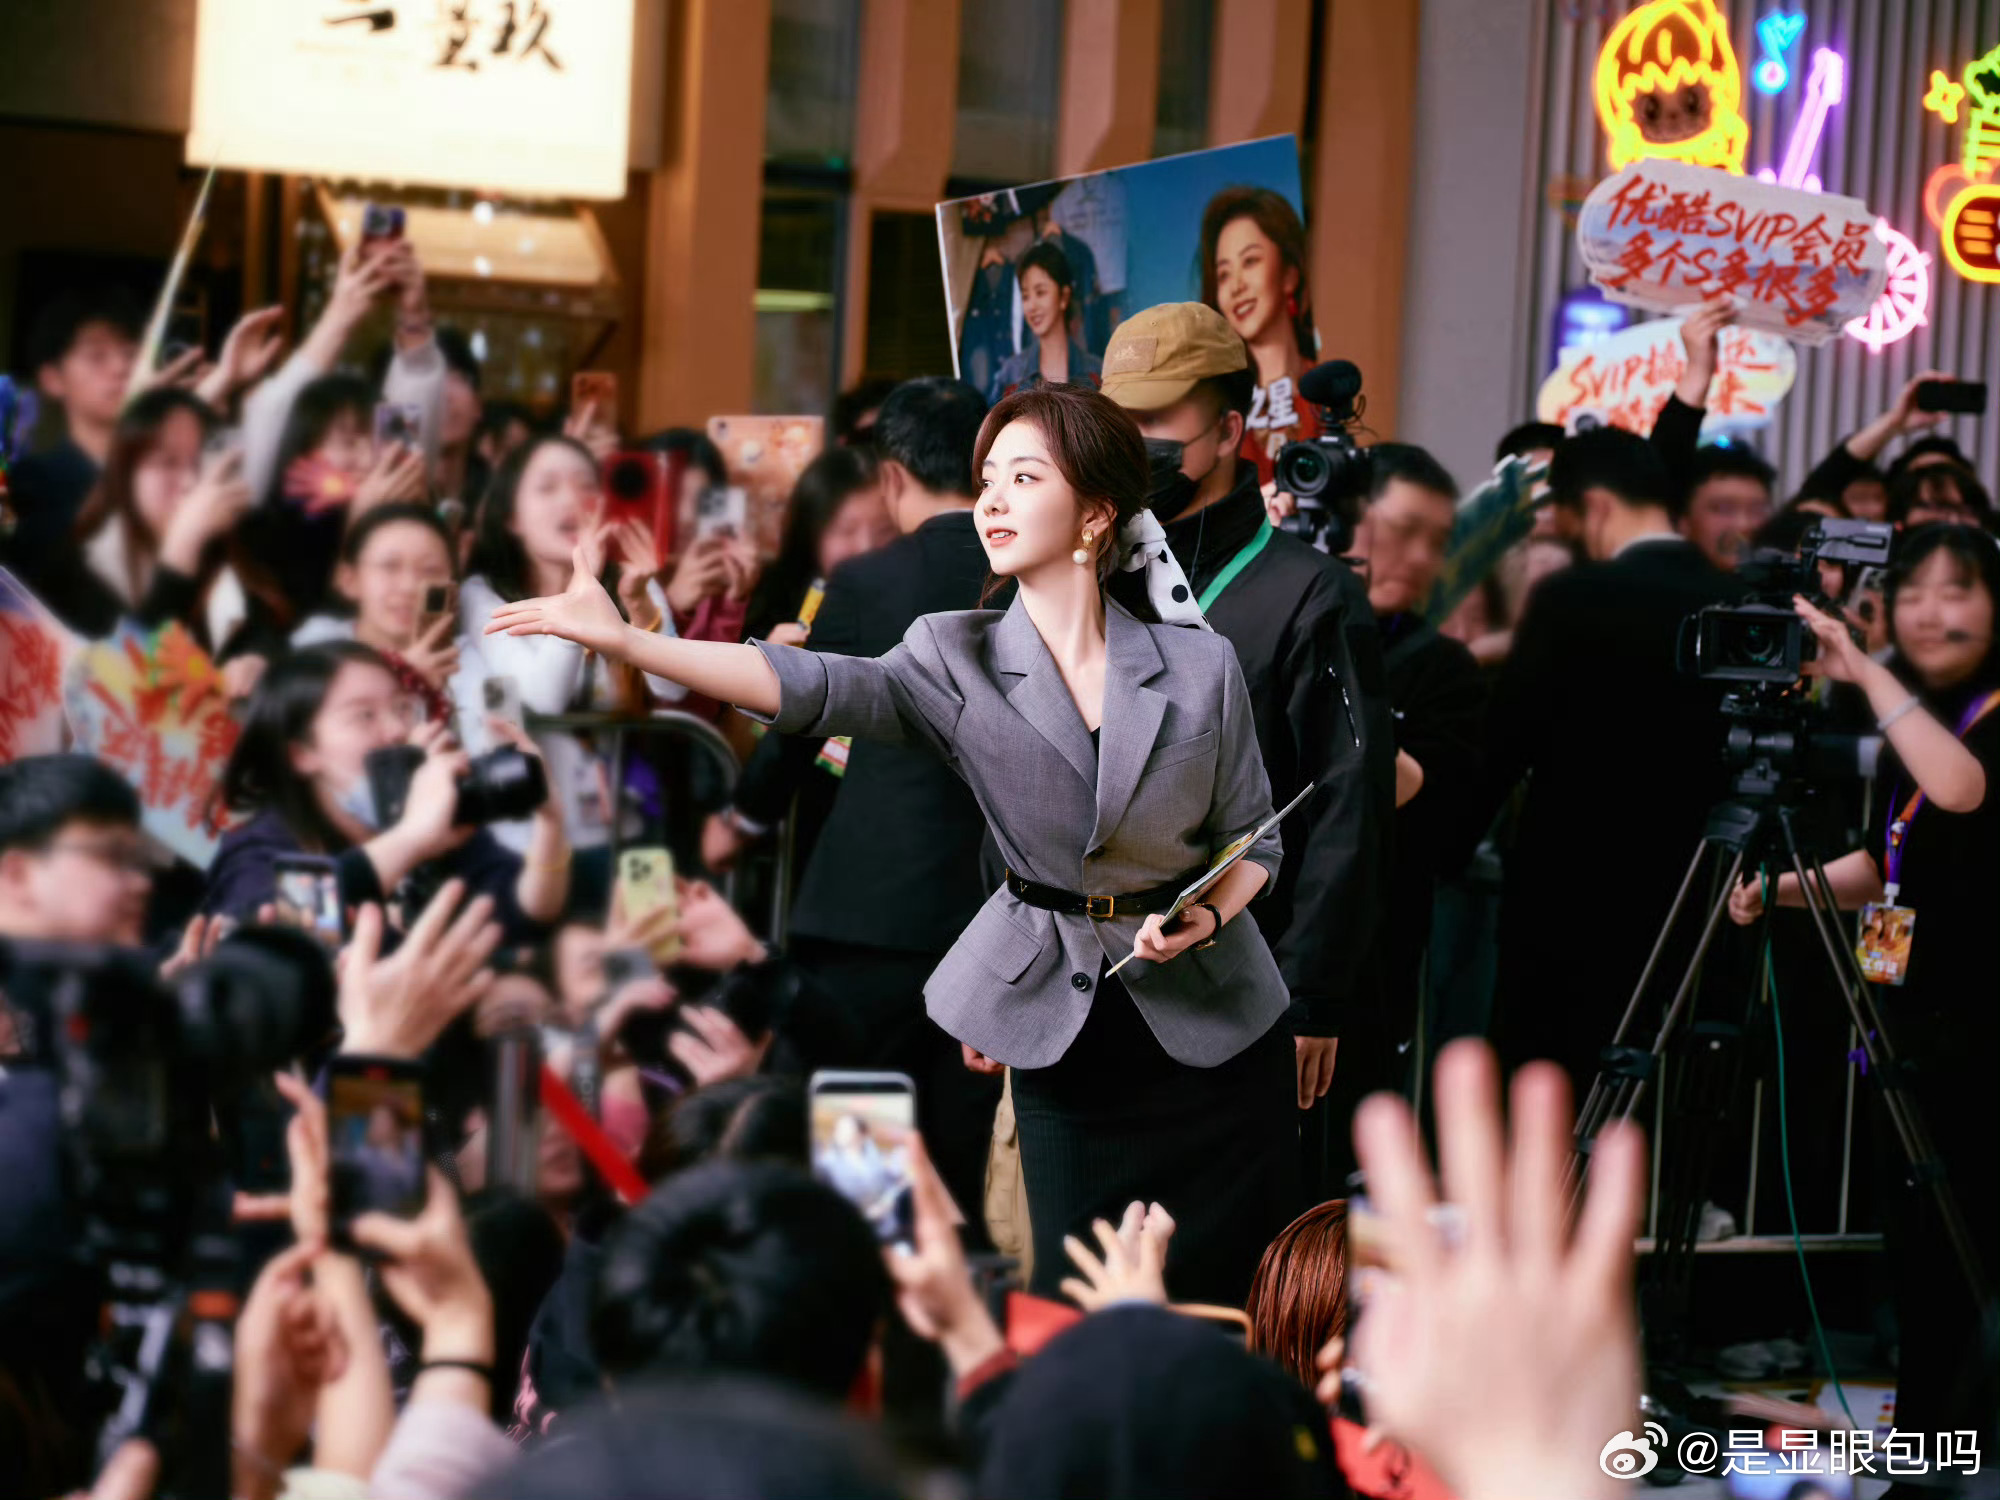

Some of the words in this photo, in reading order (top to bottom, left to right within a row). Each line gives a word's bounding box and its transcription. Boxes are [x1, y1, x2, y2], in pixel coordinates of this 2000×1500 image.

[1608, 173, 1872, 277] 优酷SVIP会员
[1601, 230, 1839, 326] 多个S多很多
